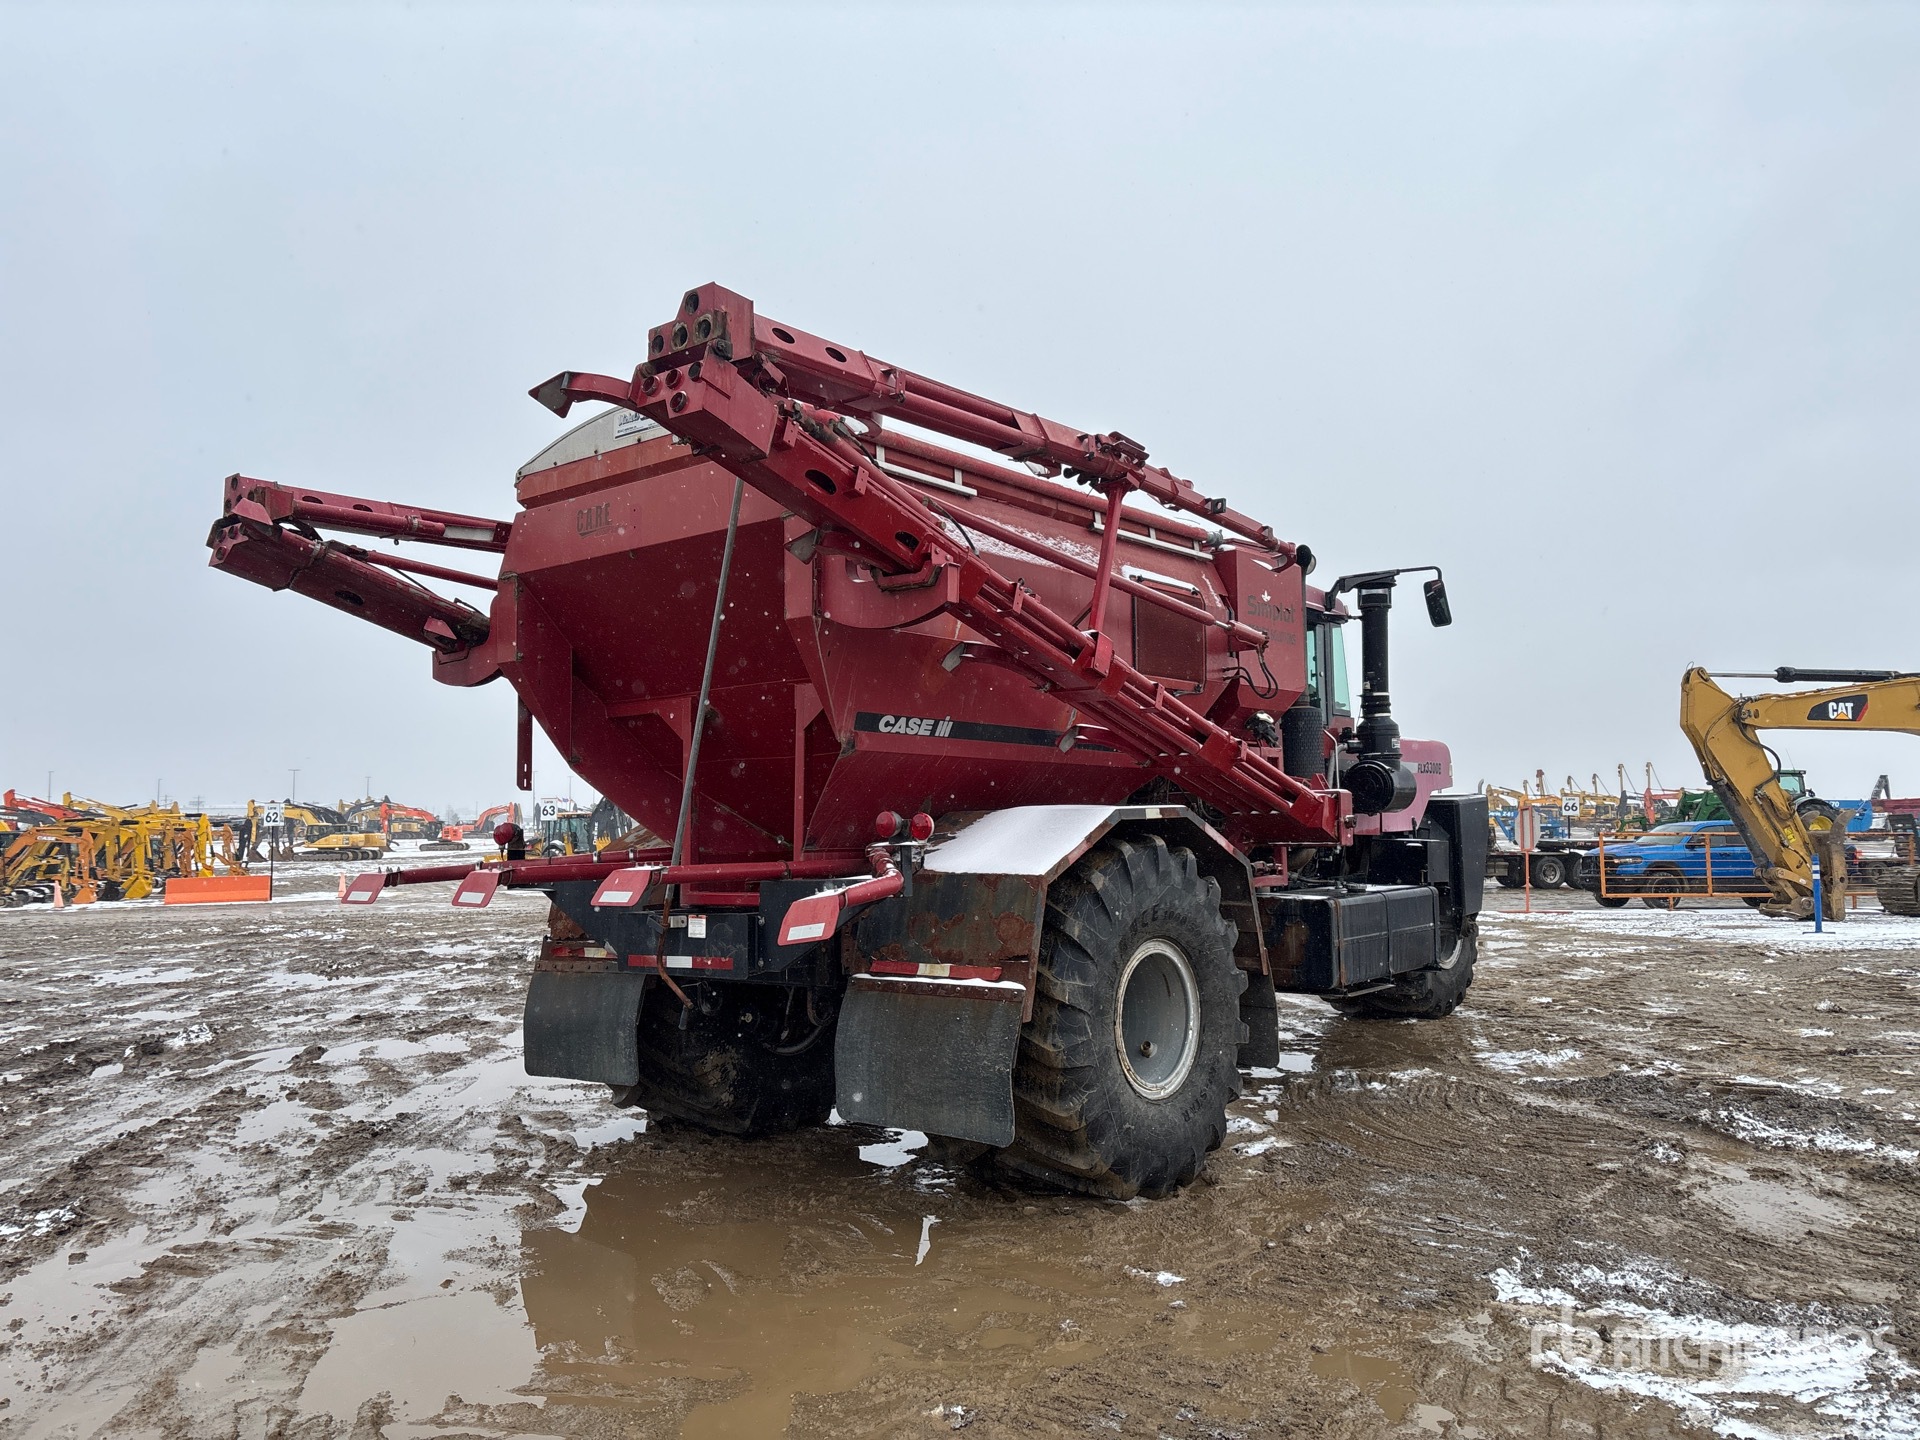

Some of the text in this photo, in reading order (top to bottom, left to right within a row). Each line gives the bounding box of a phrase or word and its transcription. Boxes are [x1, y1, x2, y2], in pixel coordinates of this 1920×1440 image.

[577, 503, 612, 532] CARE
[1247, 594, 1295, 624] Simplot
[1828, 702, 1854, 720] CAT
[878, 715, 933, 736] CASE
[542, 805, 556, 816] 63
[1563, 802, 1578, 812] 66
[265, 812, 279, 823] 62
